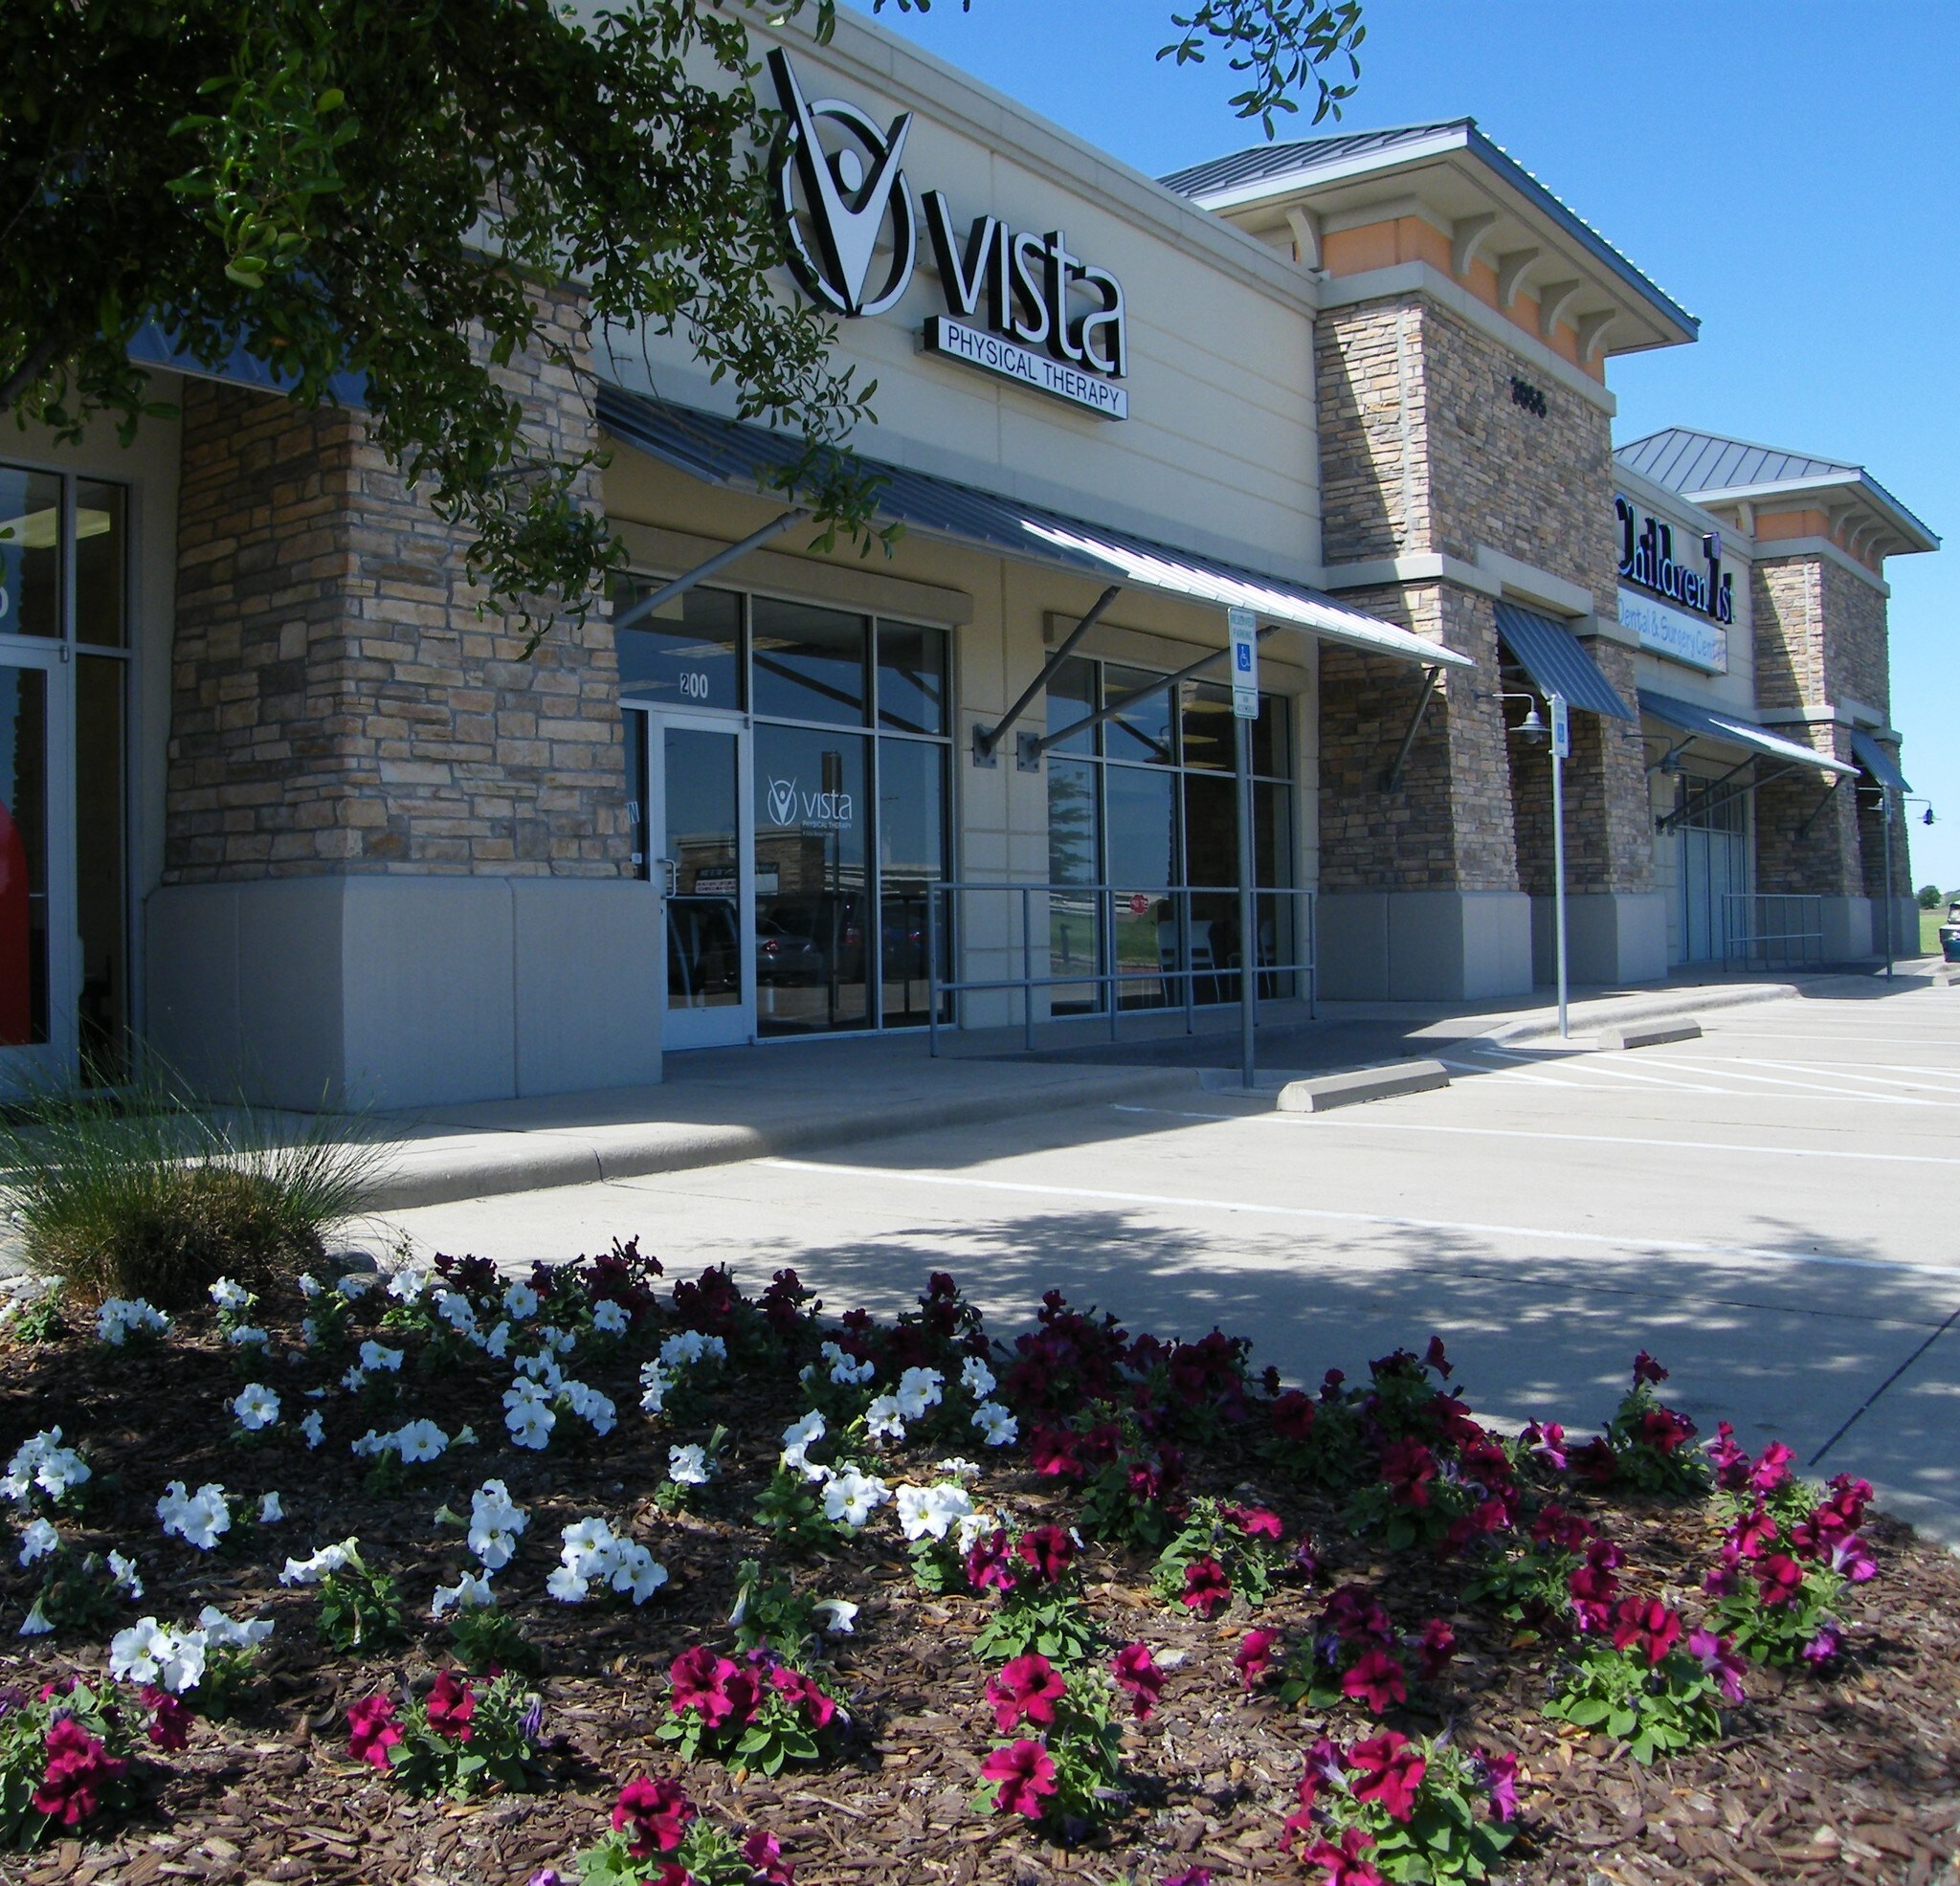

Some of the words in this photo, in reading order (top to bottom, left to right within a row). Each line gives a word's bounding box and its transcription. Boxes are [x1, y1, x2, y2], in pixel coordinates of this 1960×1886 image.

[948, 325, 1037, 380] PHYSICAL
[1043, 362, 1120, 411] THERAPY
[680, 673, 708, 699] 200
